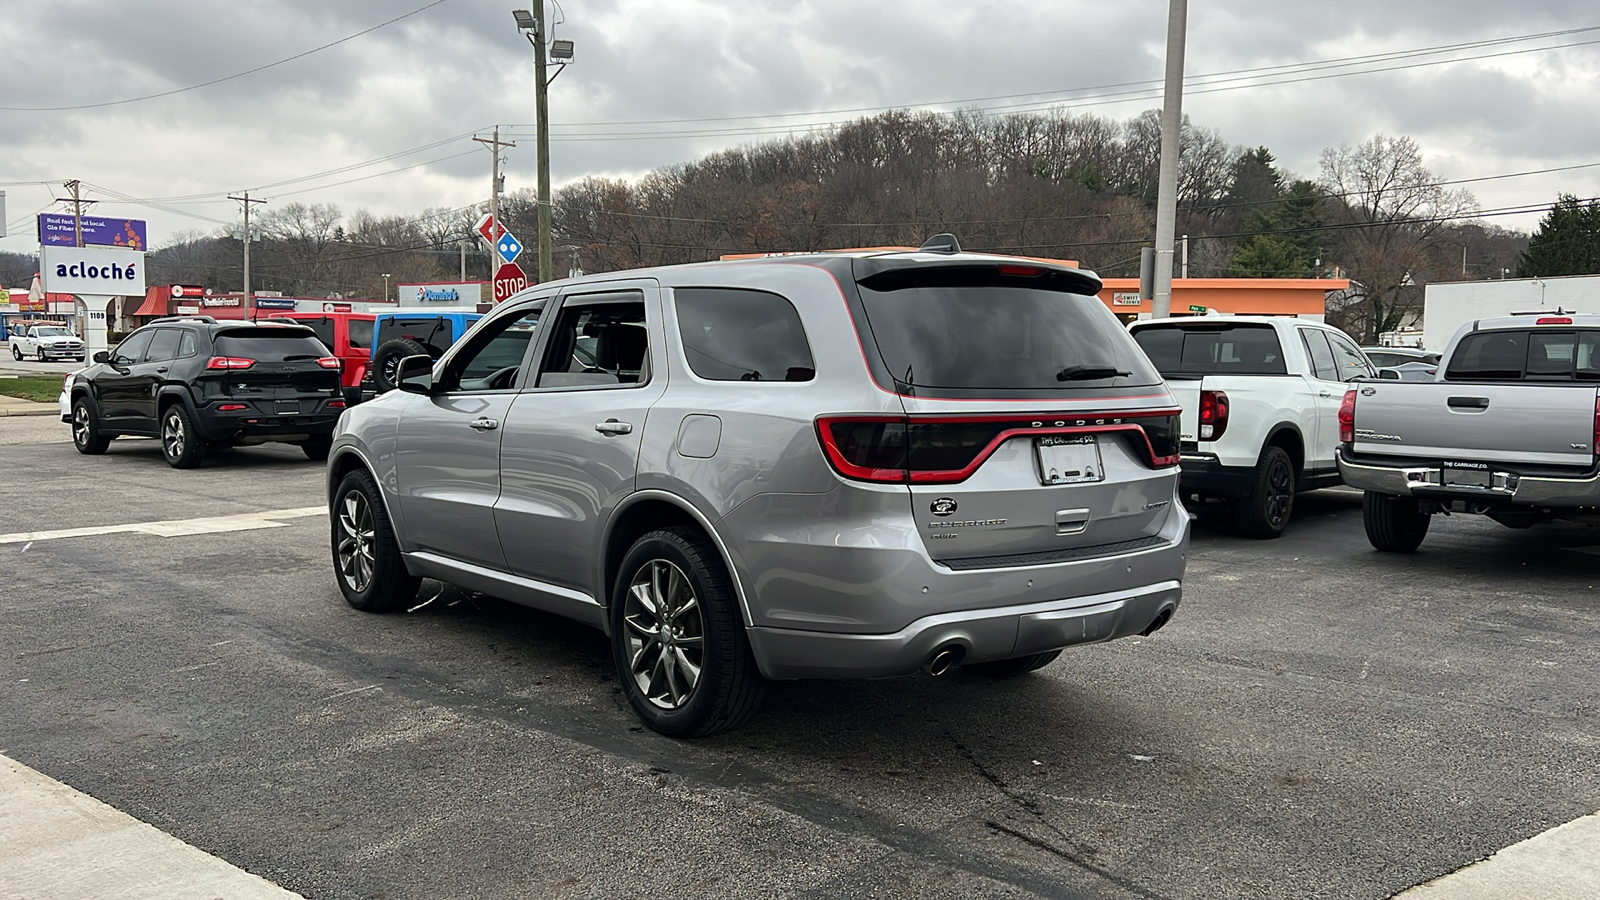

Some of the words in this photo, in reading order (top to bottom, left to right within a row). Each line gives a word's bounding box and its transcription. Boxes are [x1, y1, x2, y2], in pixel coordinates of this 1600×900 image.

[56, 261, 135, 280] acloché
[496, 278, 524, 297] STOP
[424, 289, 458, 301] Domino's
[1032, 418, 1122, 428] DODGE
[928, 518, 1008, 528] DURANGO
